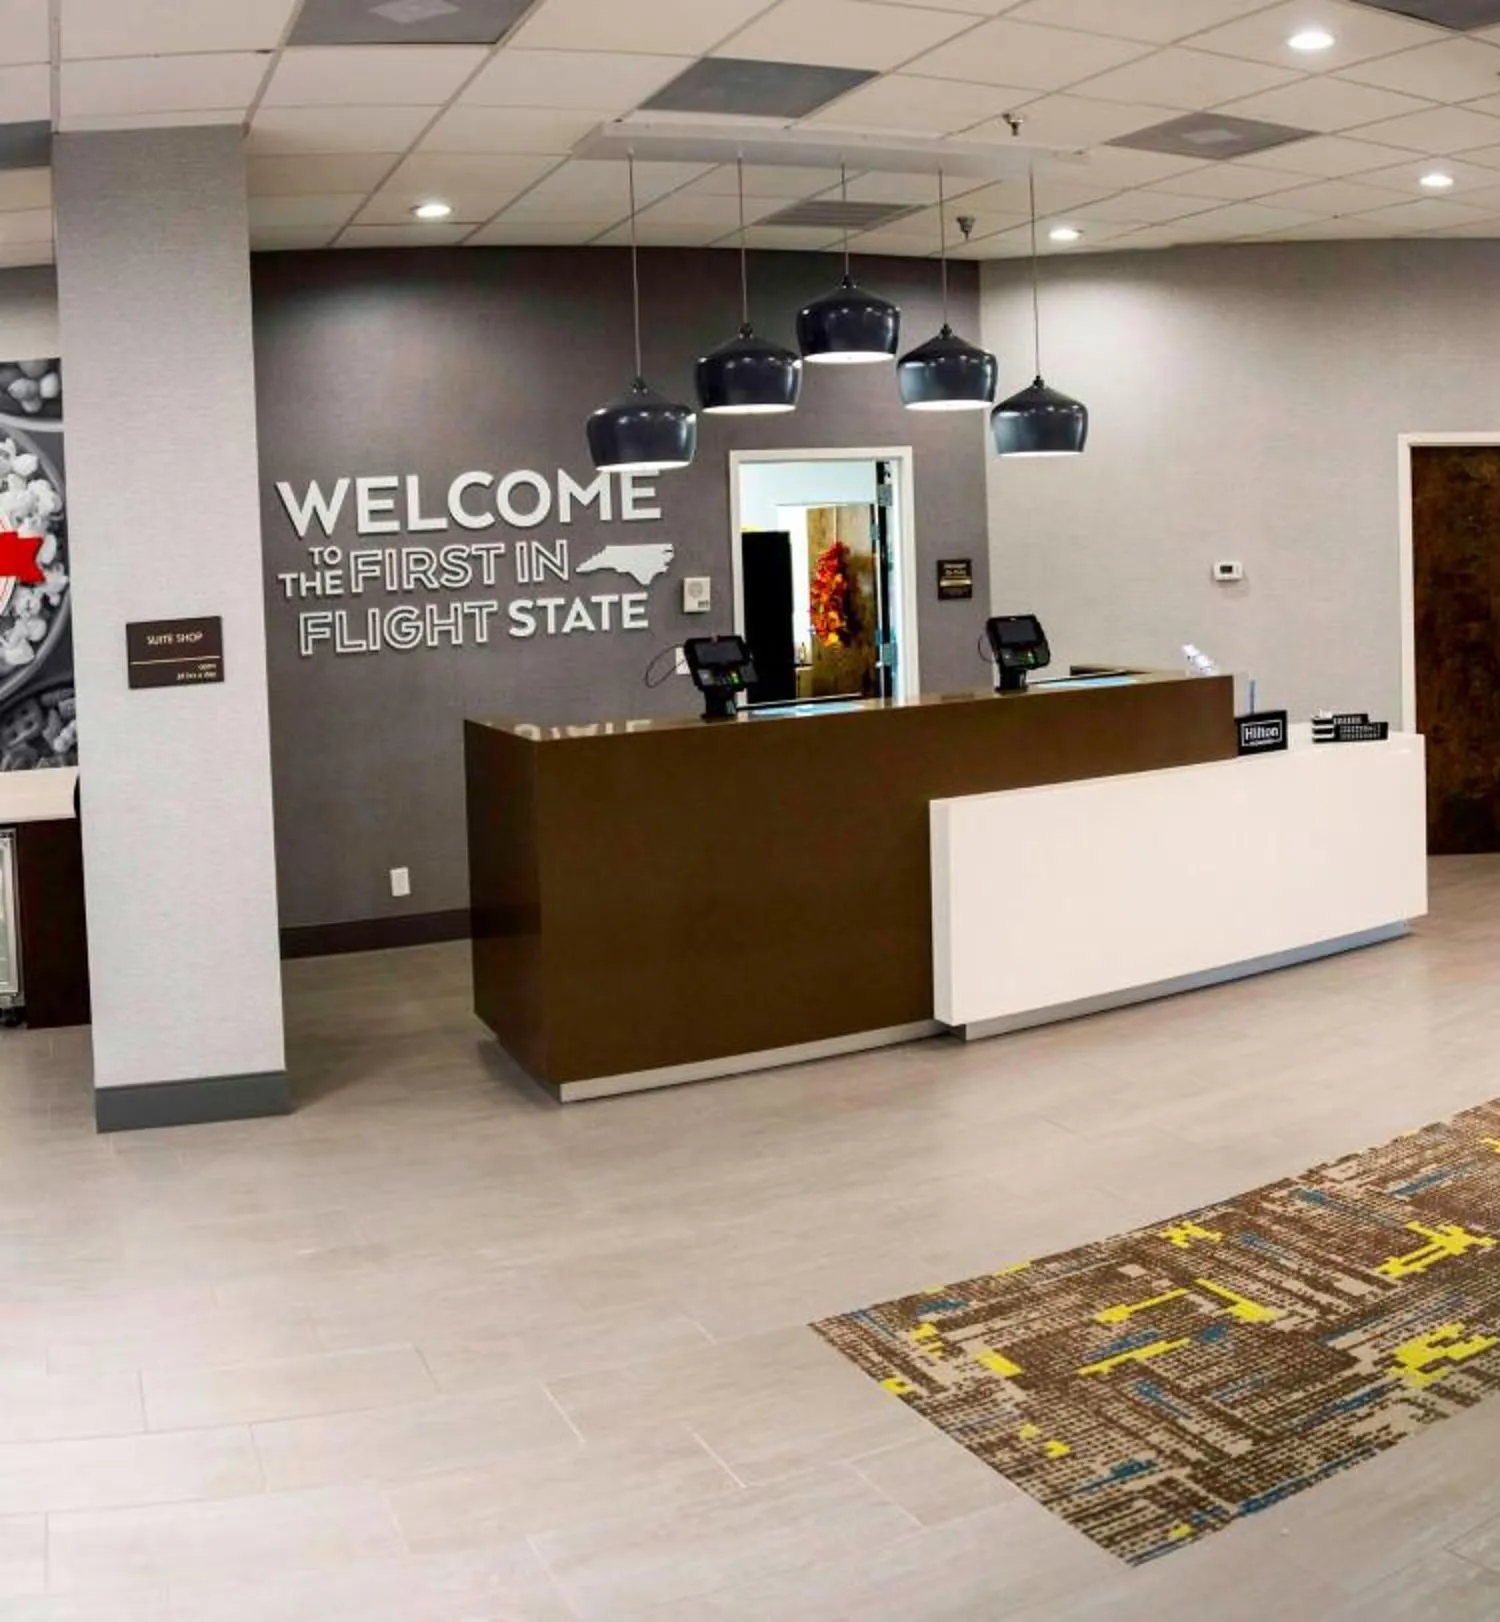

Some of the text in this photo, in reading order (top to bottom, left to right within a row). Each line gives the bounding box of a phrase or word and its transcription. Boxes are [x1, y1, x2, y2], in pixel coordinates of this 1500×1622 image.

[275, 468, 662, 538] WELCOME
[277, 539, 570, 598] THE FIRST IN
[309, 545, 342, 566] TO
[146, 631, 203, 645] SUITE SHOP
[299, 592, 649, 656] FLIGHT STATE
[1245, 725, 1279, 741] Hilton
